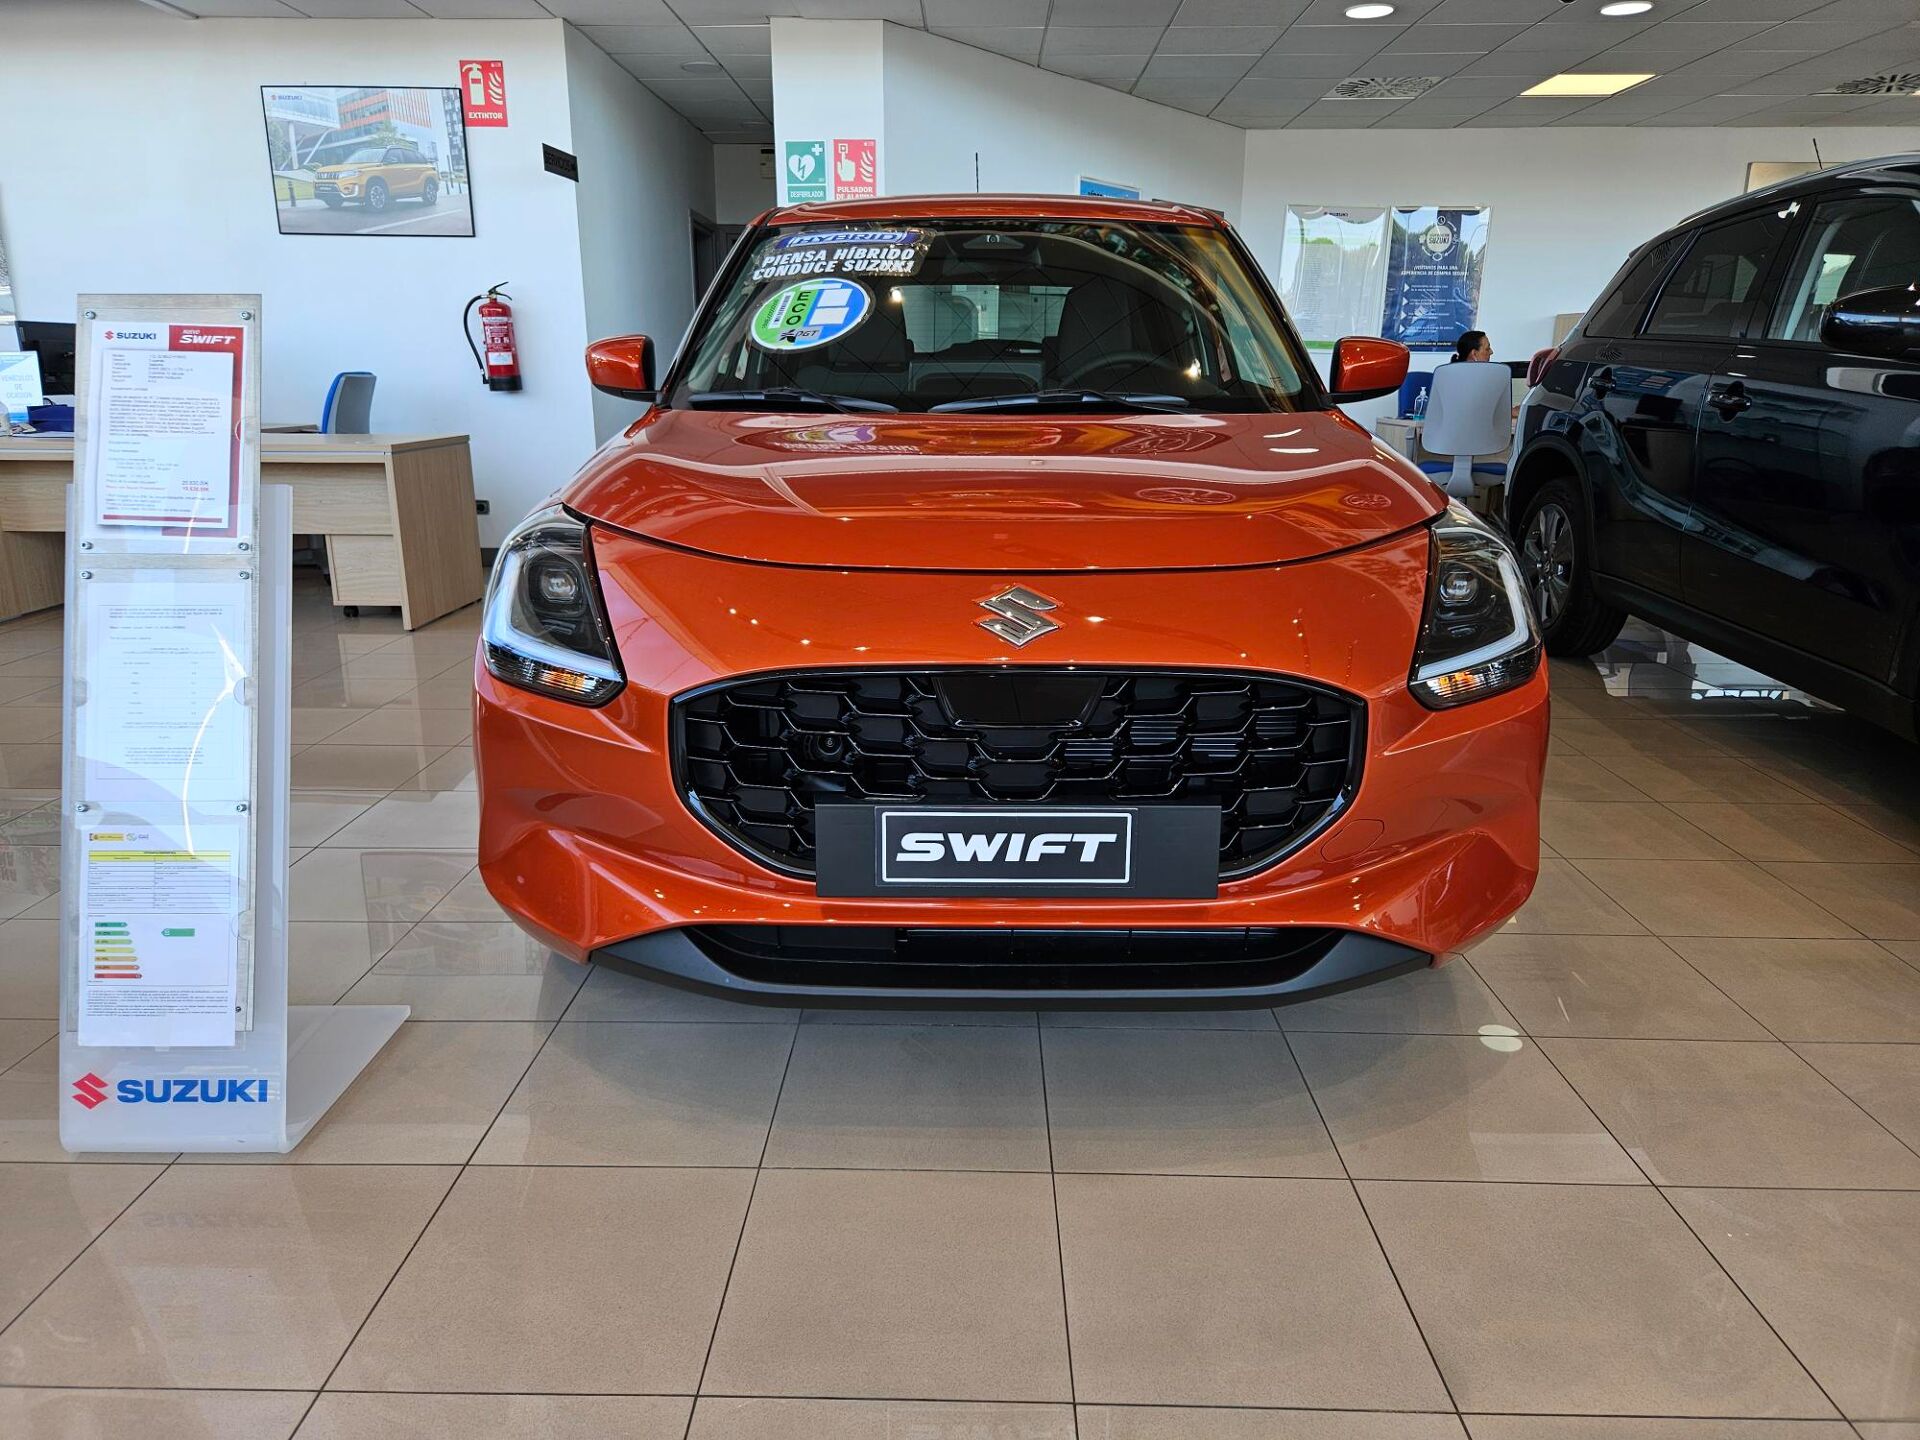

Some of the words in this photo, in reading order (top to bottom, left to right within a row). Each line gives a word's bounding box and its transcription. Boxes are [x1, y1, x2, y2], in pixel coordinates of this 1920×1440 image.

[468, 111, 503, 120] EXTINTOR
[794, 232, 898, 245] HYBRID
[762, 250, 826, 268] PIENSA
[833, 246, 916, 261] HÍBRIDO
[753, 260, 836, 281] CONDUCE
[842, 259, 915, 273] SUZUKI
[785, 291, 812, 325] ECO
[117, 332, 156, 340] SUZUKI
[179, 334, 236, 345] SWIFT
[896, 832, 1117, 862] SWIFT
[117, 1079, 268, 1103] SUZUKI
